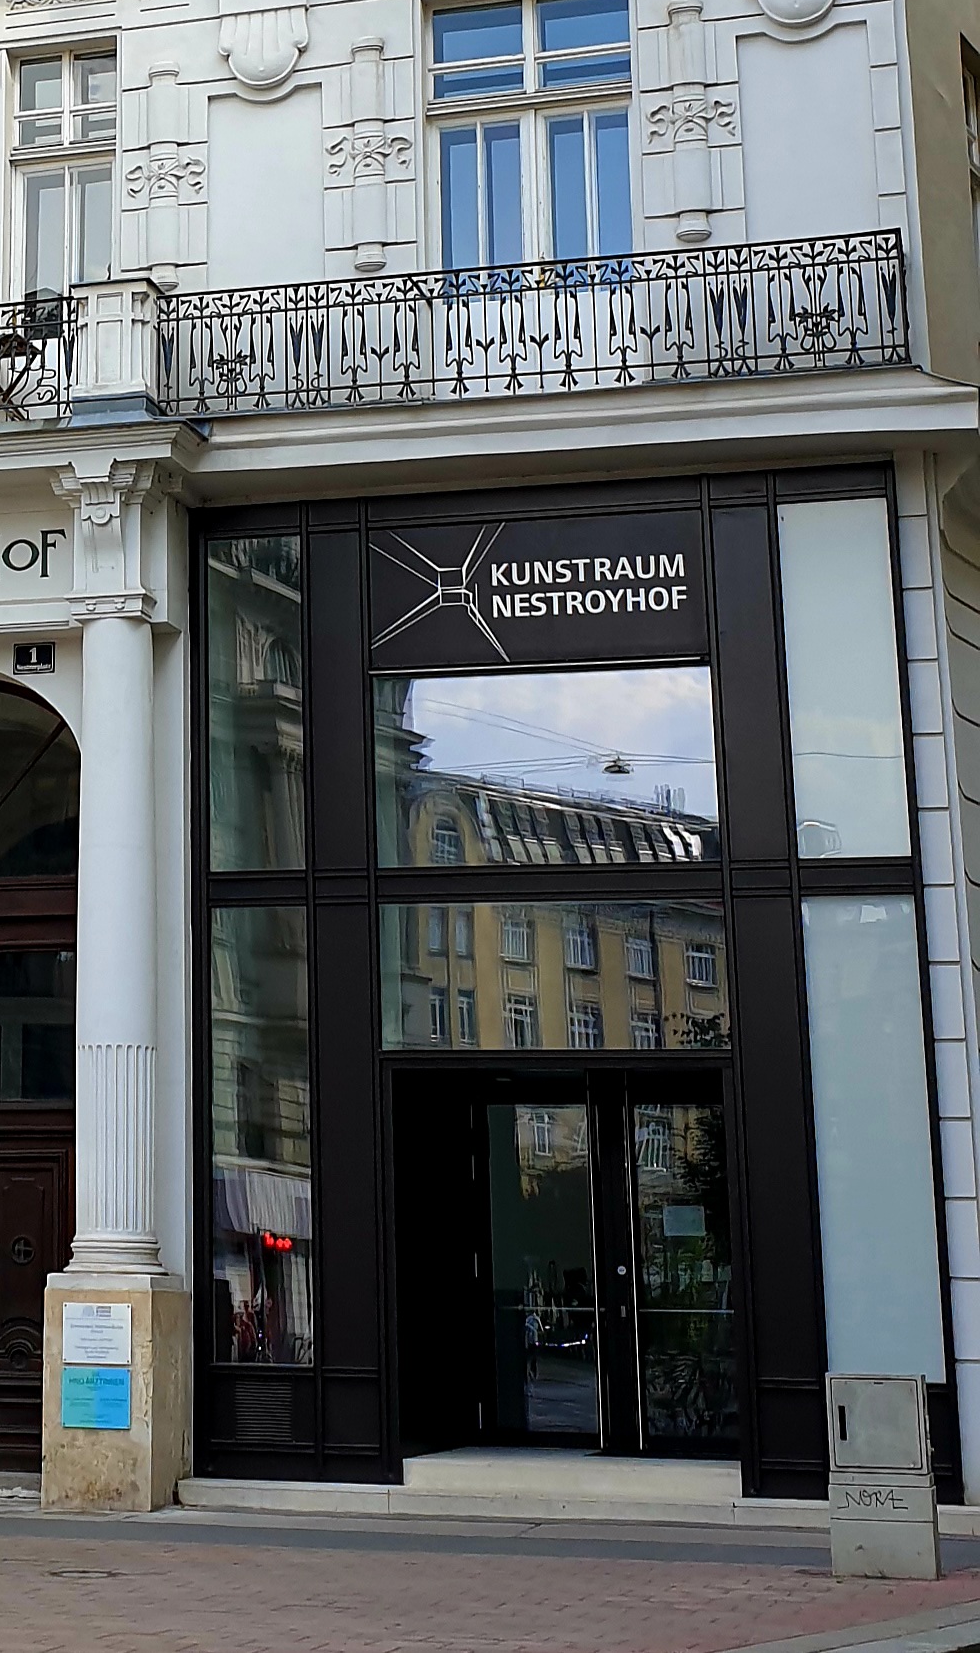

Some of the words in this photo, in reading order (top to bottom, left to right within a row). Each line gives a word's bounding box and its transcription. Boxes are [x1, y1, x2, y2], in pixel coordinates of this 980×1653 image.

[491, 553, 686, 587] KUNSTRAUM
[492, 585, 688, 619] NESTROYHOF
[29, 647, 38, 664] 1
